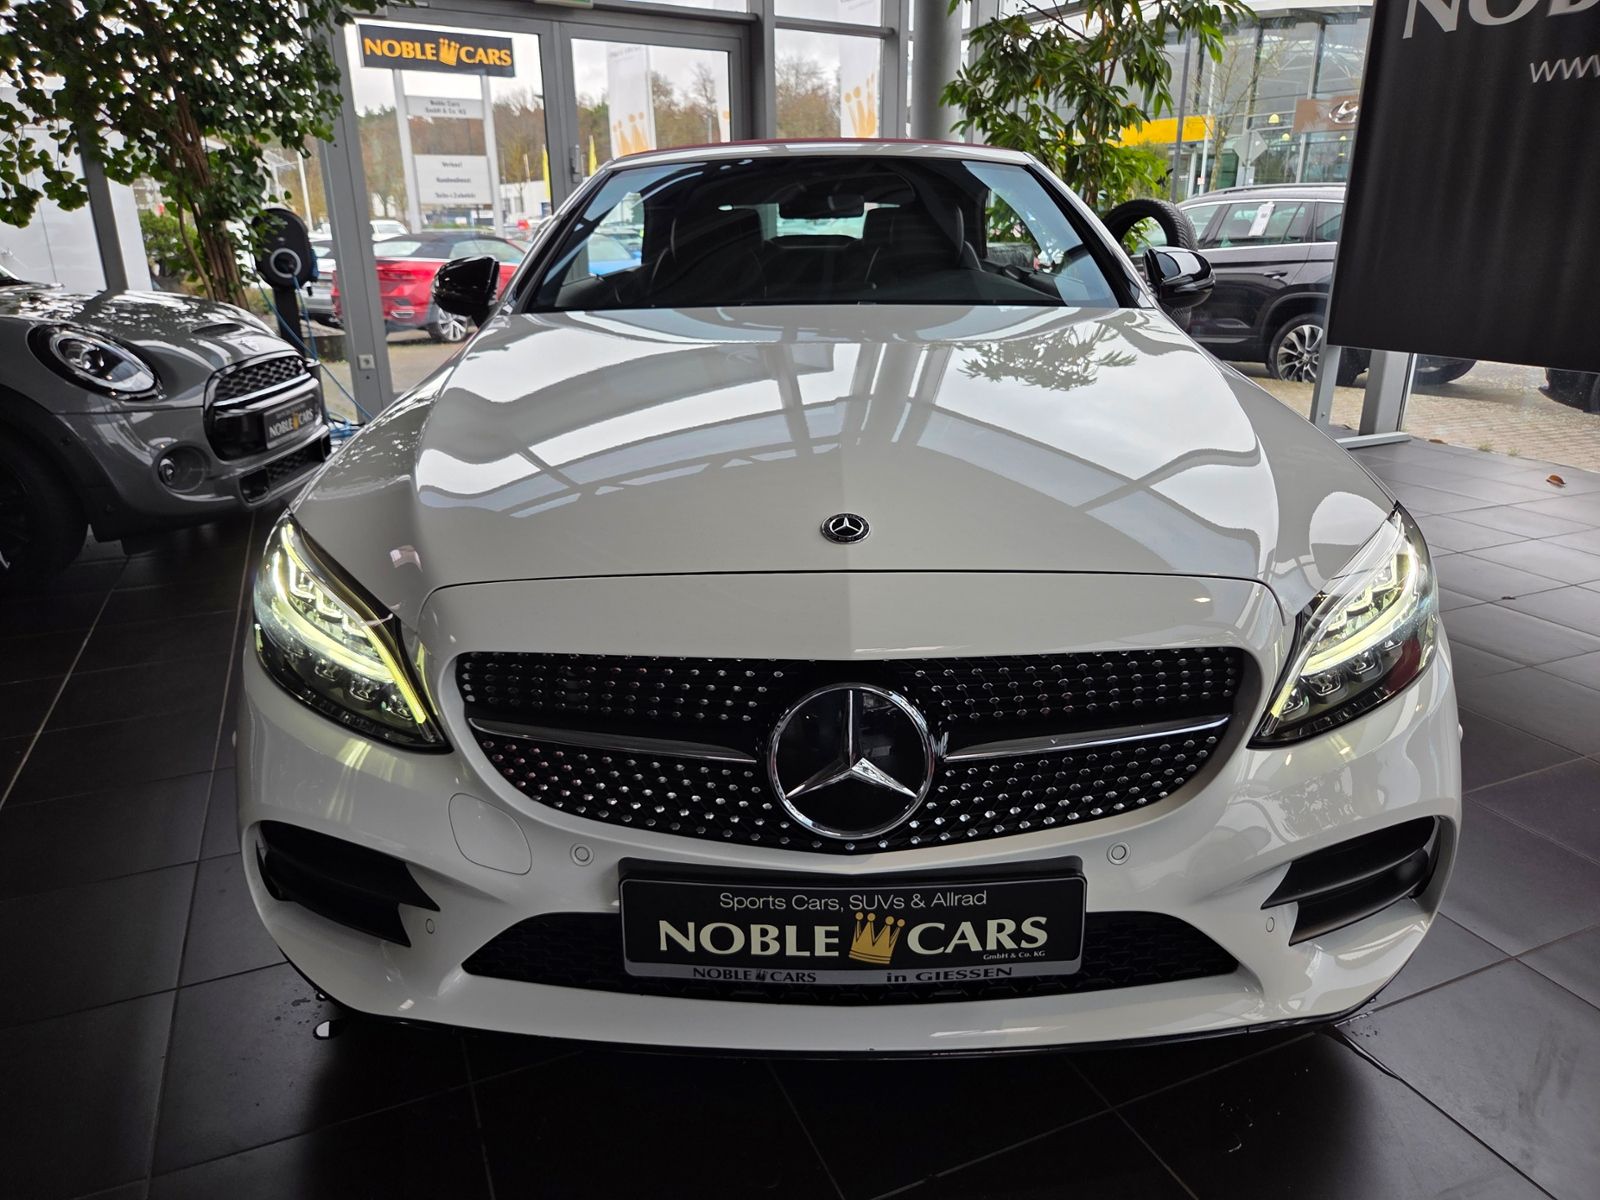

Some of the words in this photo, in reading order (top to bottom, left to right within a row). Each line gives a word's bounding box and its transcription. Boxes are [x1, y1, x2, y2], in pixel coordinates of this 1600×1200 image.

[364, 38, 436, 62] NOBLE
[459, 46, 513, 67] CARS
[269, 417, 293, 438] NOBLE
[719, 892, 786, 911] Sports
[791, 894, 844, 913] Cars,
[849, 894, 905, 910] SUVs
[910, 893, 926, 908] &
[931, 890, 987, 907] Allrad
[658, 920, 839, 957] NOBLE
[907, 916, 1048, 955] CARS
[983, 952, 1008, 960] GmbH
[693, 967, 752, 981] NOBLE
[770, 970, 817, 983] CARS
[886, 972, 907, 983] in
[916, 967, 1013, 982] GIESSEN
